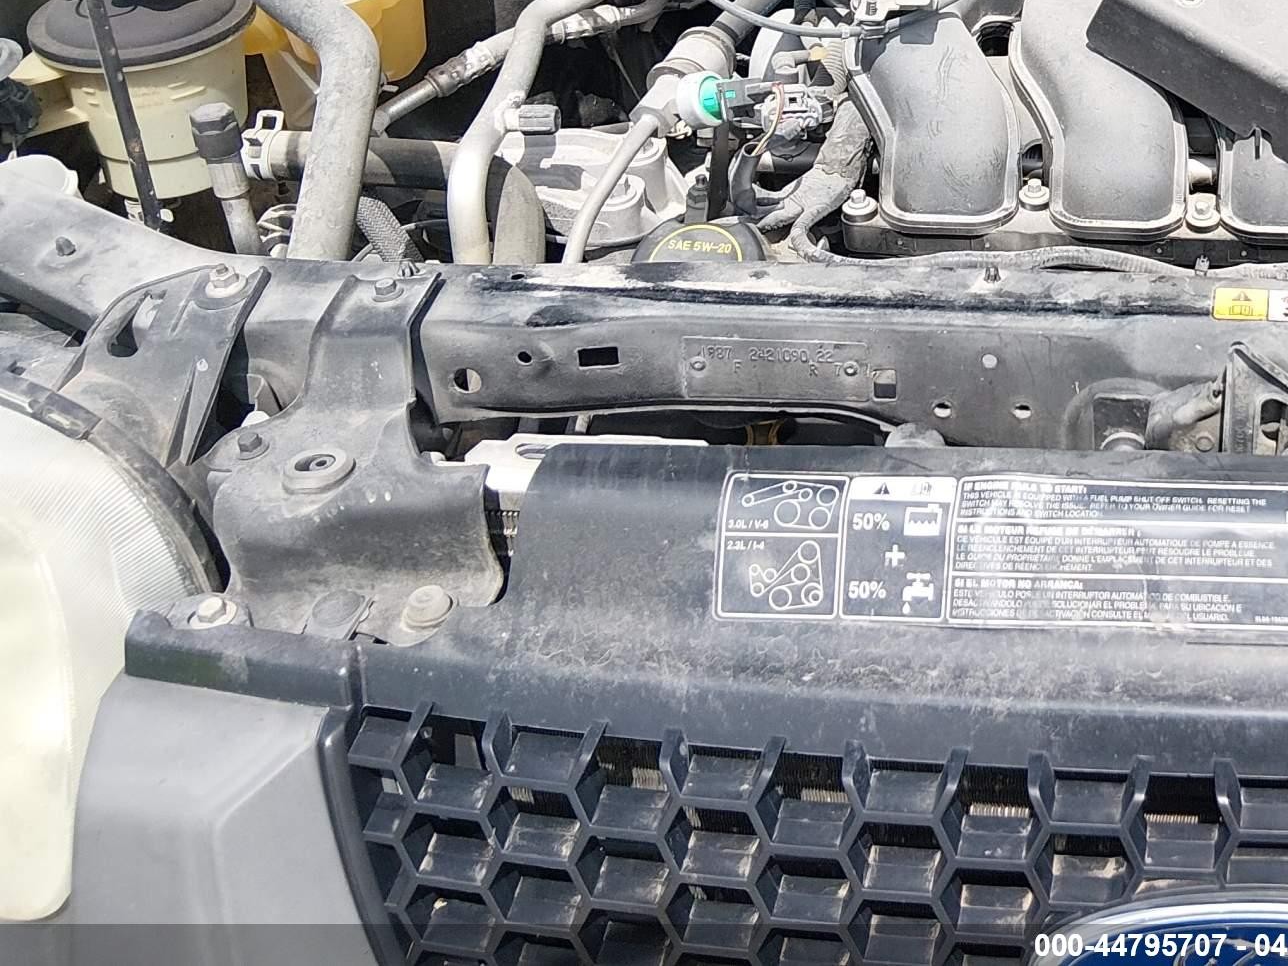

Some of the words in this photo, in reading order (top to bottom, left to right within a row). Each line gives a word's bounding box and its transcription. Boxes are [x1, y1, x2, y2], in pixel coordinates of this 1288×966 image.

[667, 239, 692, 251] SAE
[693, 241, 732, 254] 5W-20
[1090, 494, 1108, 503] FUEL
[1109, 494, 1133, 503] PUMP
[852, 512, 890, 531] 50%
[848, 580, 887, 599] 50%
